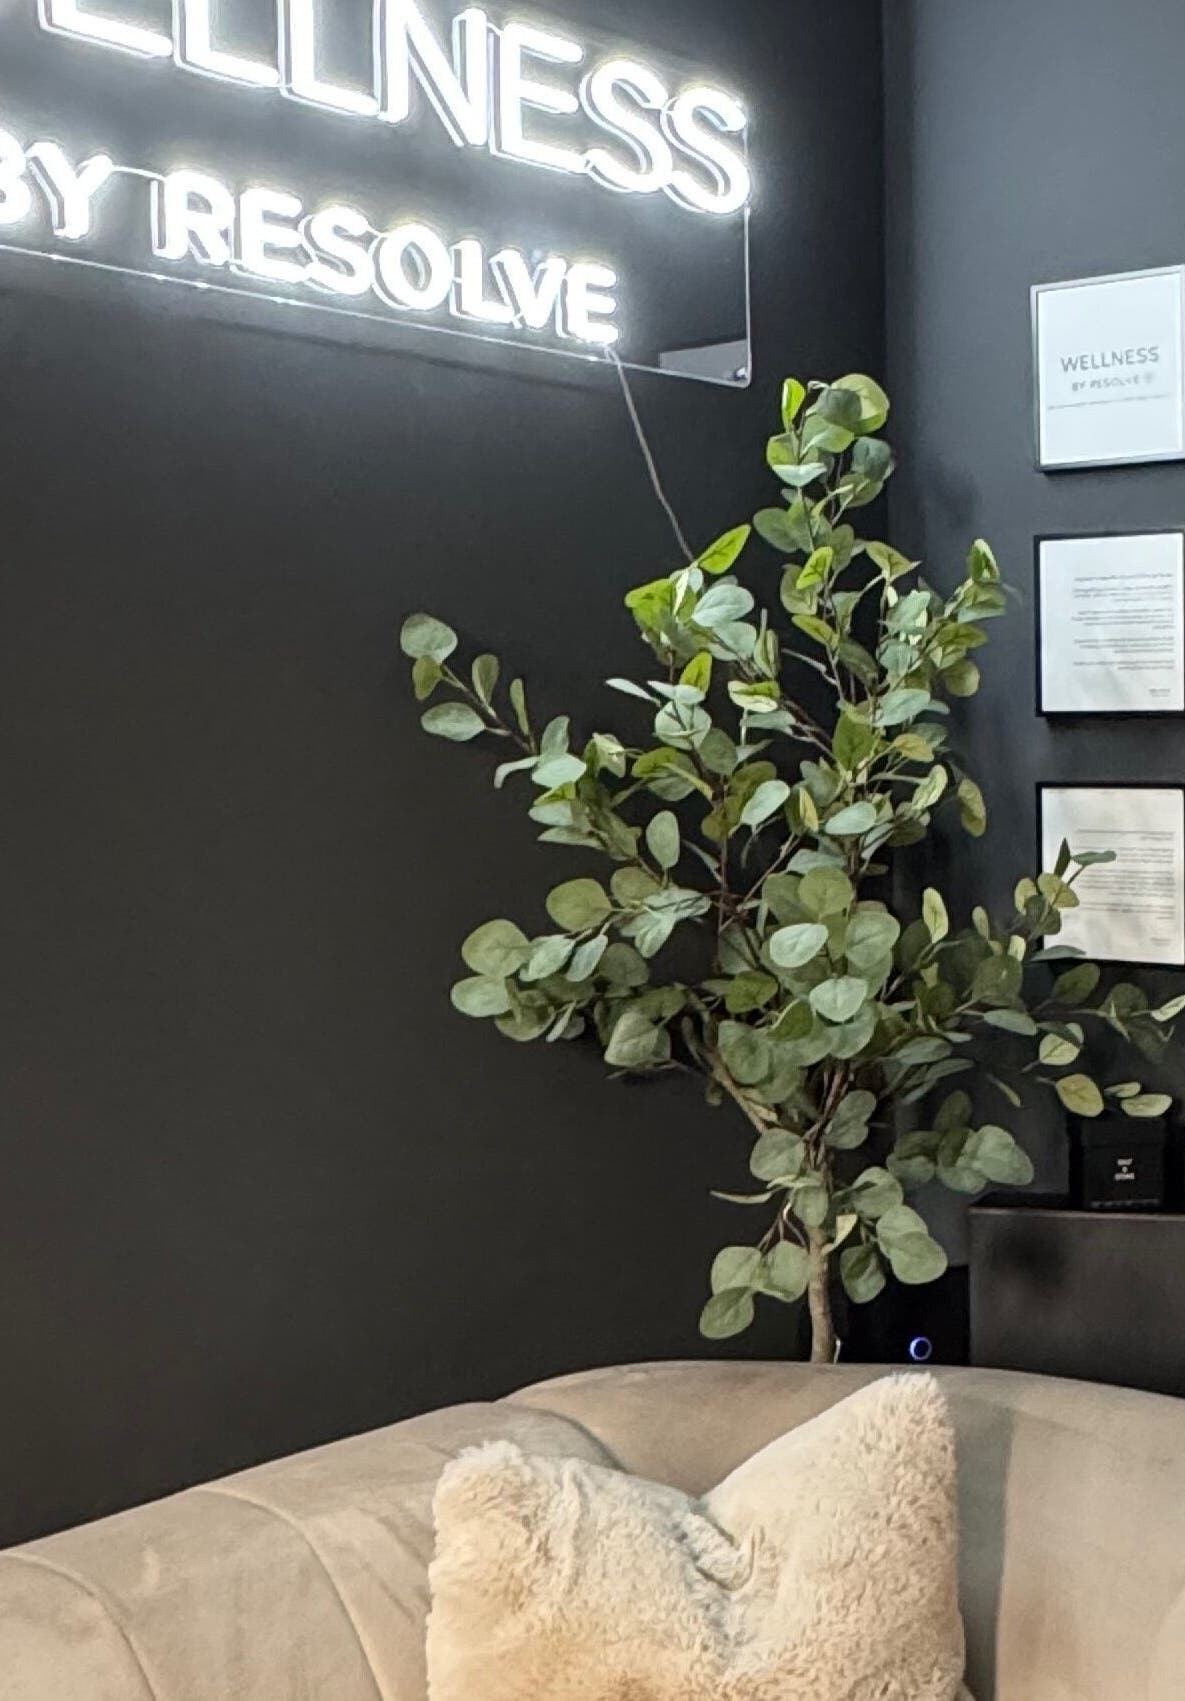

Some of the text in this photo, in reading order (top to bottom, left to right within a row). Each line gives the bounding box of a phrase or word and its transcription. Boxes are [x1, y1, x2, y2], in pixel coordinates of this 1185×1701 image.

[38, 0, 750, 214] LLNESS
[150, 168, 619, 346] RESOLVE
[1060, 346, 1159, 372] WELLNESS
